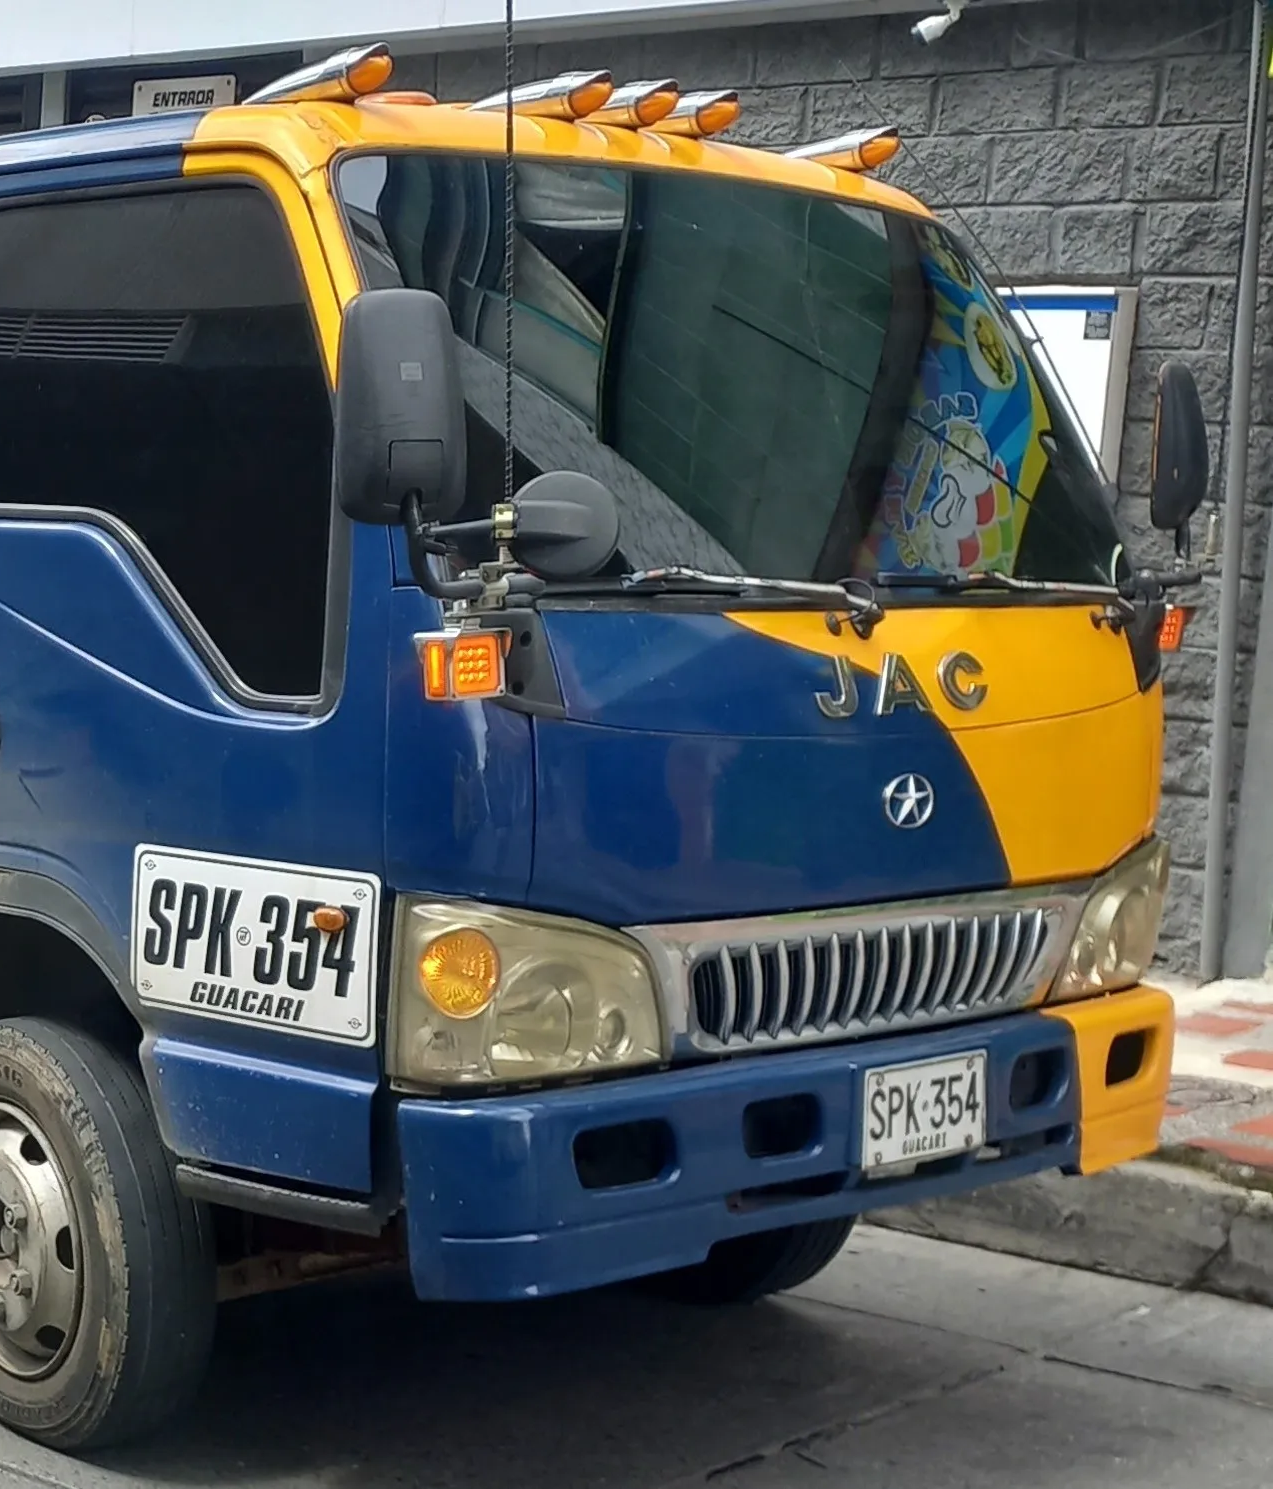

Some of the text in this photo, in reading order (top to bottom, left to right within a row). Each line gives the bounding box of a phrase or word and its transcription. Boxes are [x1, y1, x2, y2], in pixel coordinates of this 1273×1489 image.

[152, 89, 215, 108] ENTRADA
[814, 652, 989, 718] JAC
[143, 878, 361, 998] SPK 354
[189, 981, 306, 1022] GUACARI
[902, 1132, 947, 1155] GUACARI
